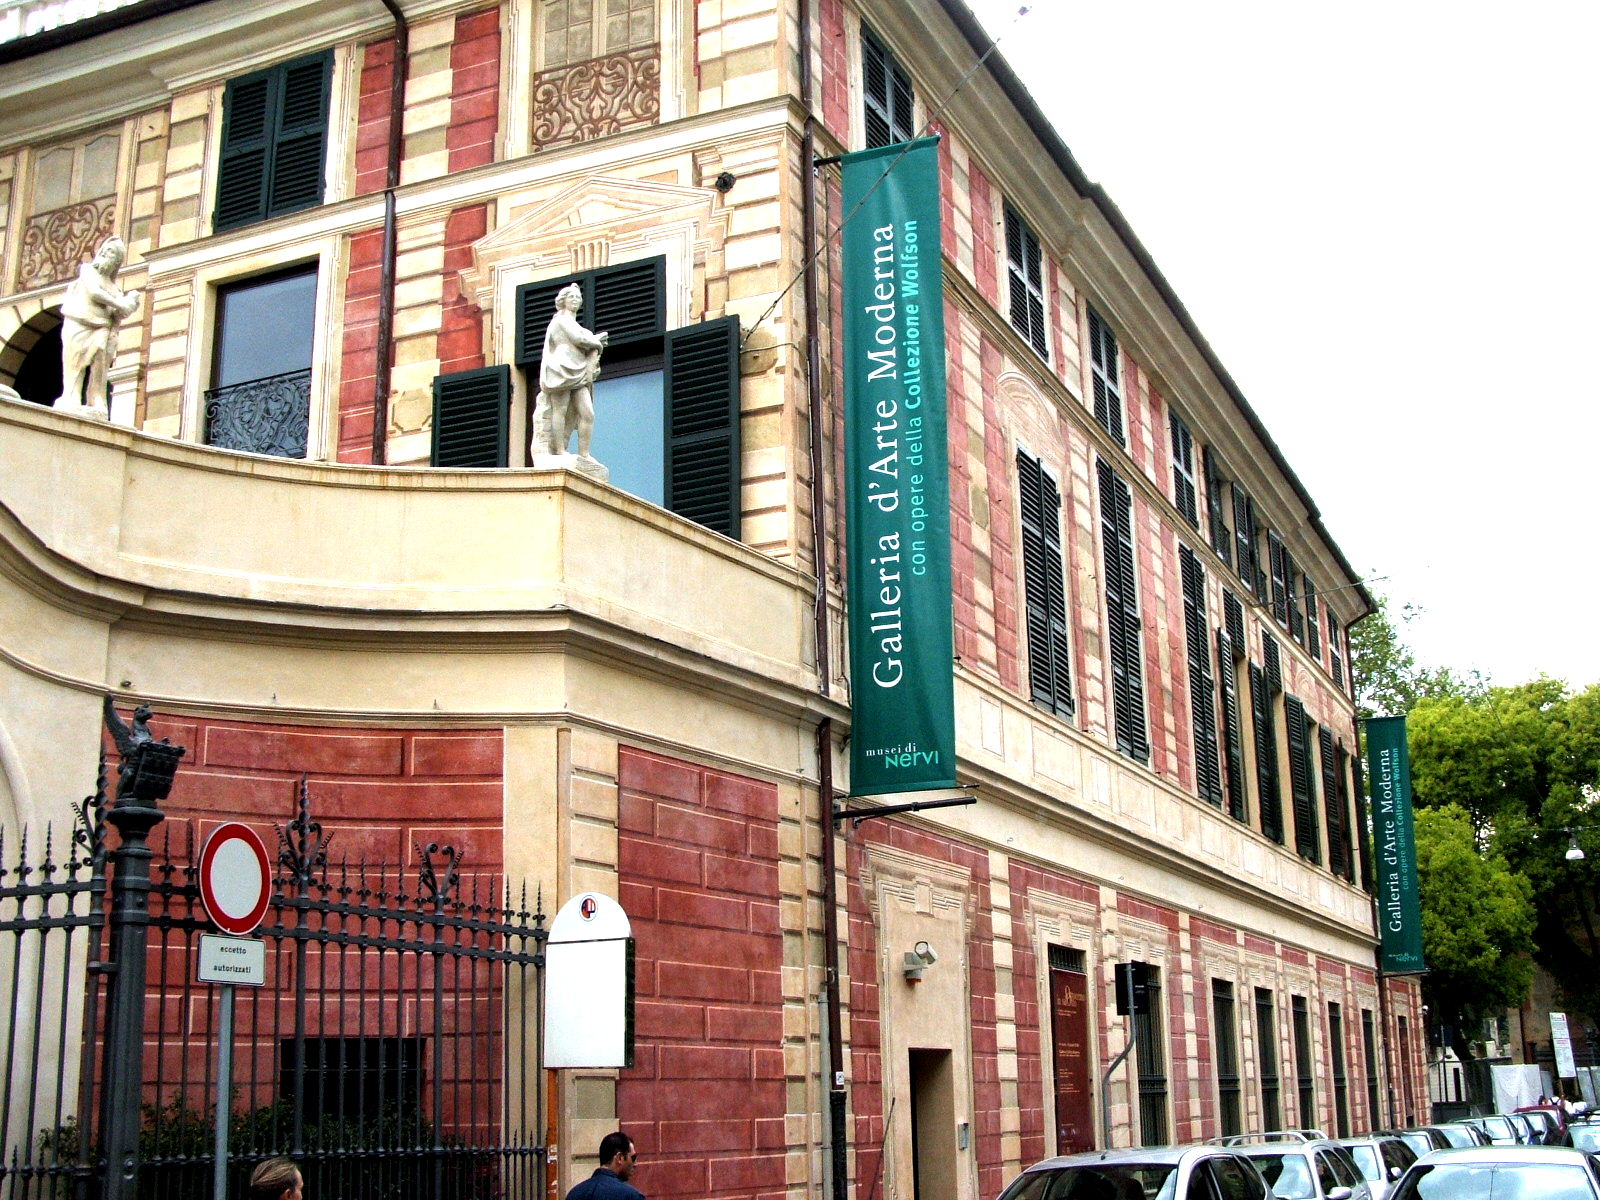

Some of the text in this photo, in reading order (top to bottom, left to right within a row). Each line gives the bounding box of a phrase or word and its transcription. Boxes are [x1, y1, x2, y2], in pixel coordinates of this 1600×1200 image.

[901, 220, 929, 576] con opere della Collezione Wolfson
[865, 223, 903, 688] Galleria d'Arte Moderna
[866, 742, 917, 757] musei di
[1379, 749, 1402, 932] Galleria d'Arte Moderna
[213, 964, 252, 974] autorizzati
[220, 946, 247, 955] eccetto
